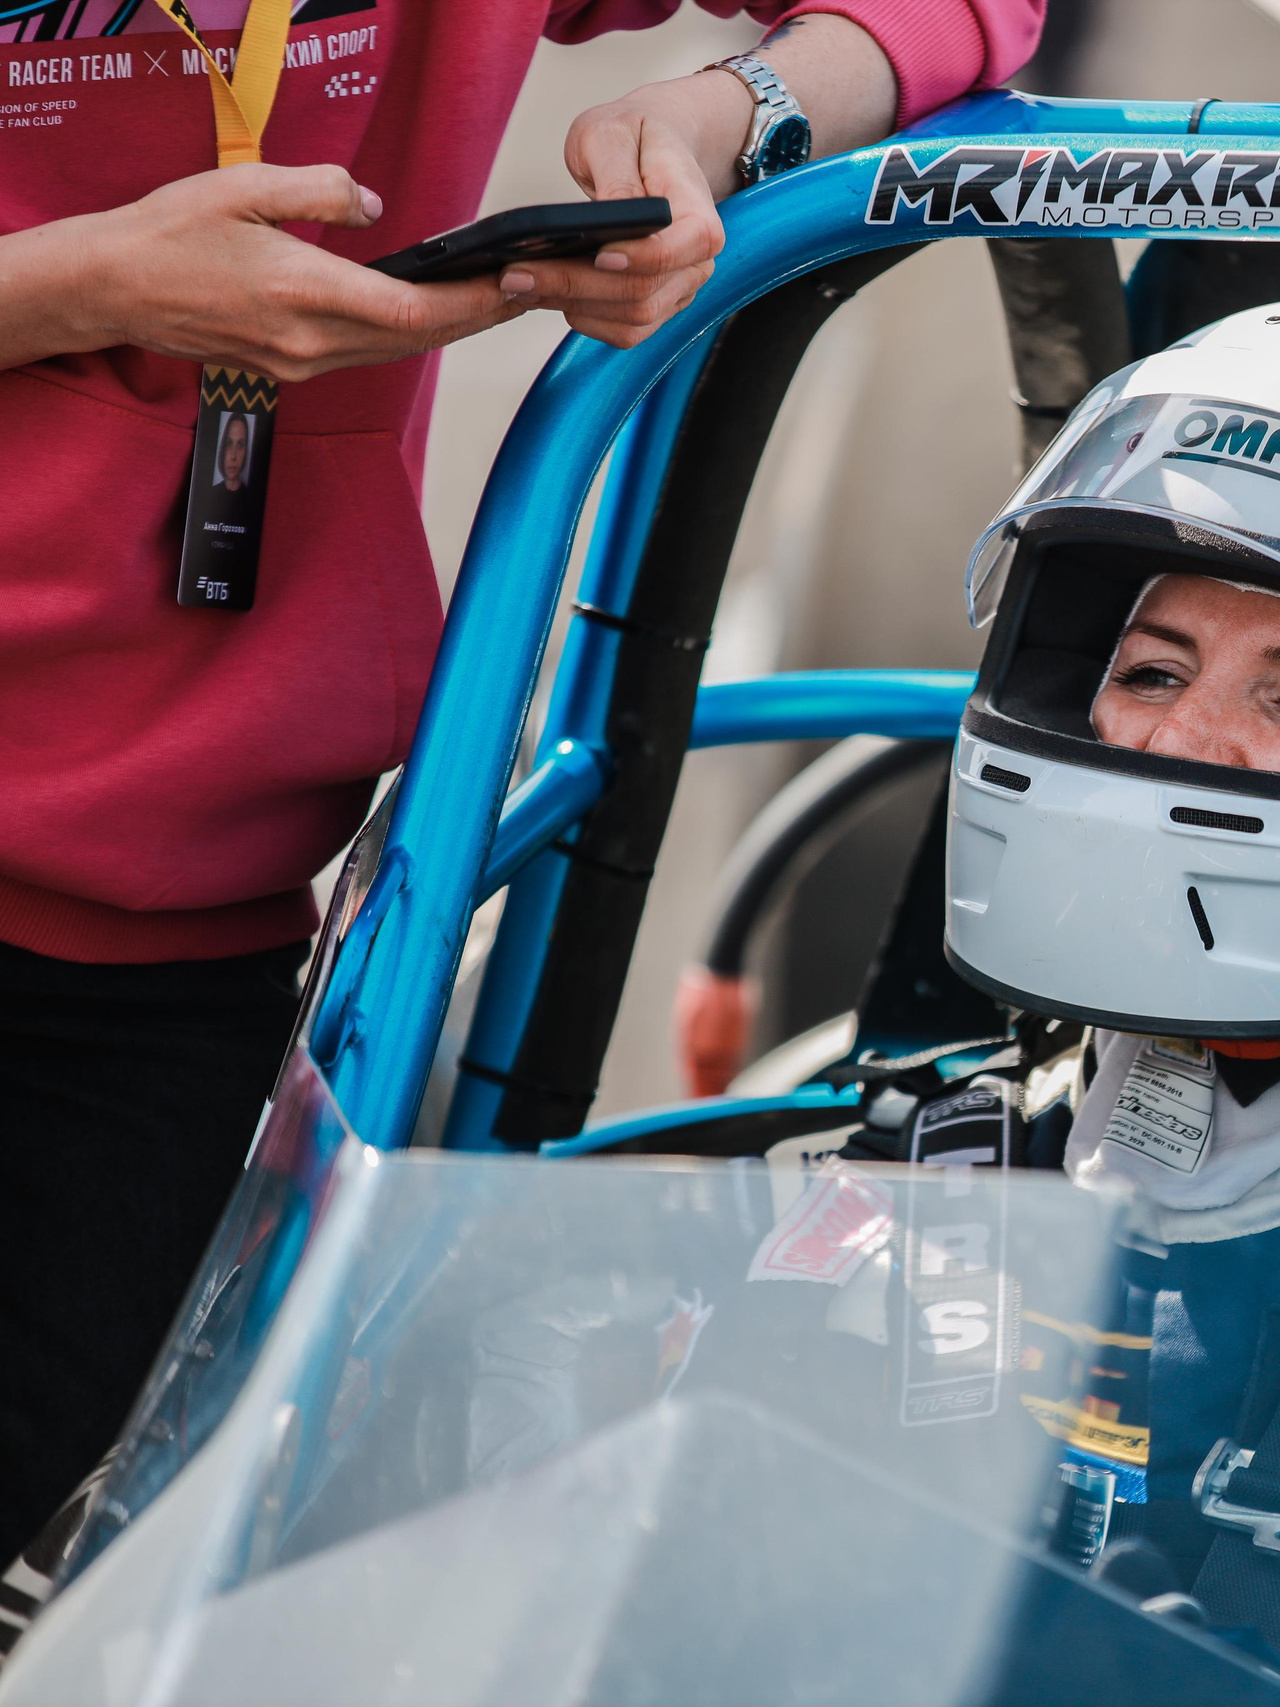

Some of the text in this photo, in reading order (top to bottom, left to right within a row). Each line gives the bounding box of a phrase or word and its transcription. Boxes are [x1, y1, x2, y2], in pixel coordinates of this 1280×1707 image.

[9, 57, 73, 87] RACER
[81, 52, 132, 82] TEAM
[327, 25, 378, 60] СПОРТ
[24, 102, 39, 113] OF
[41, 99, 77, 111] SPEED
[8, 117, 29, 128] FAN
[33, 115, 62, 127] CLUB
[206, 581, 229, 600] ВТБ
